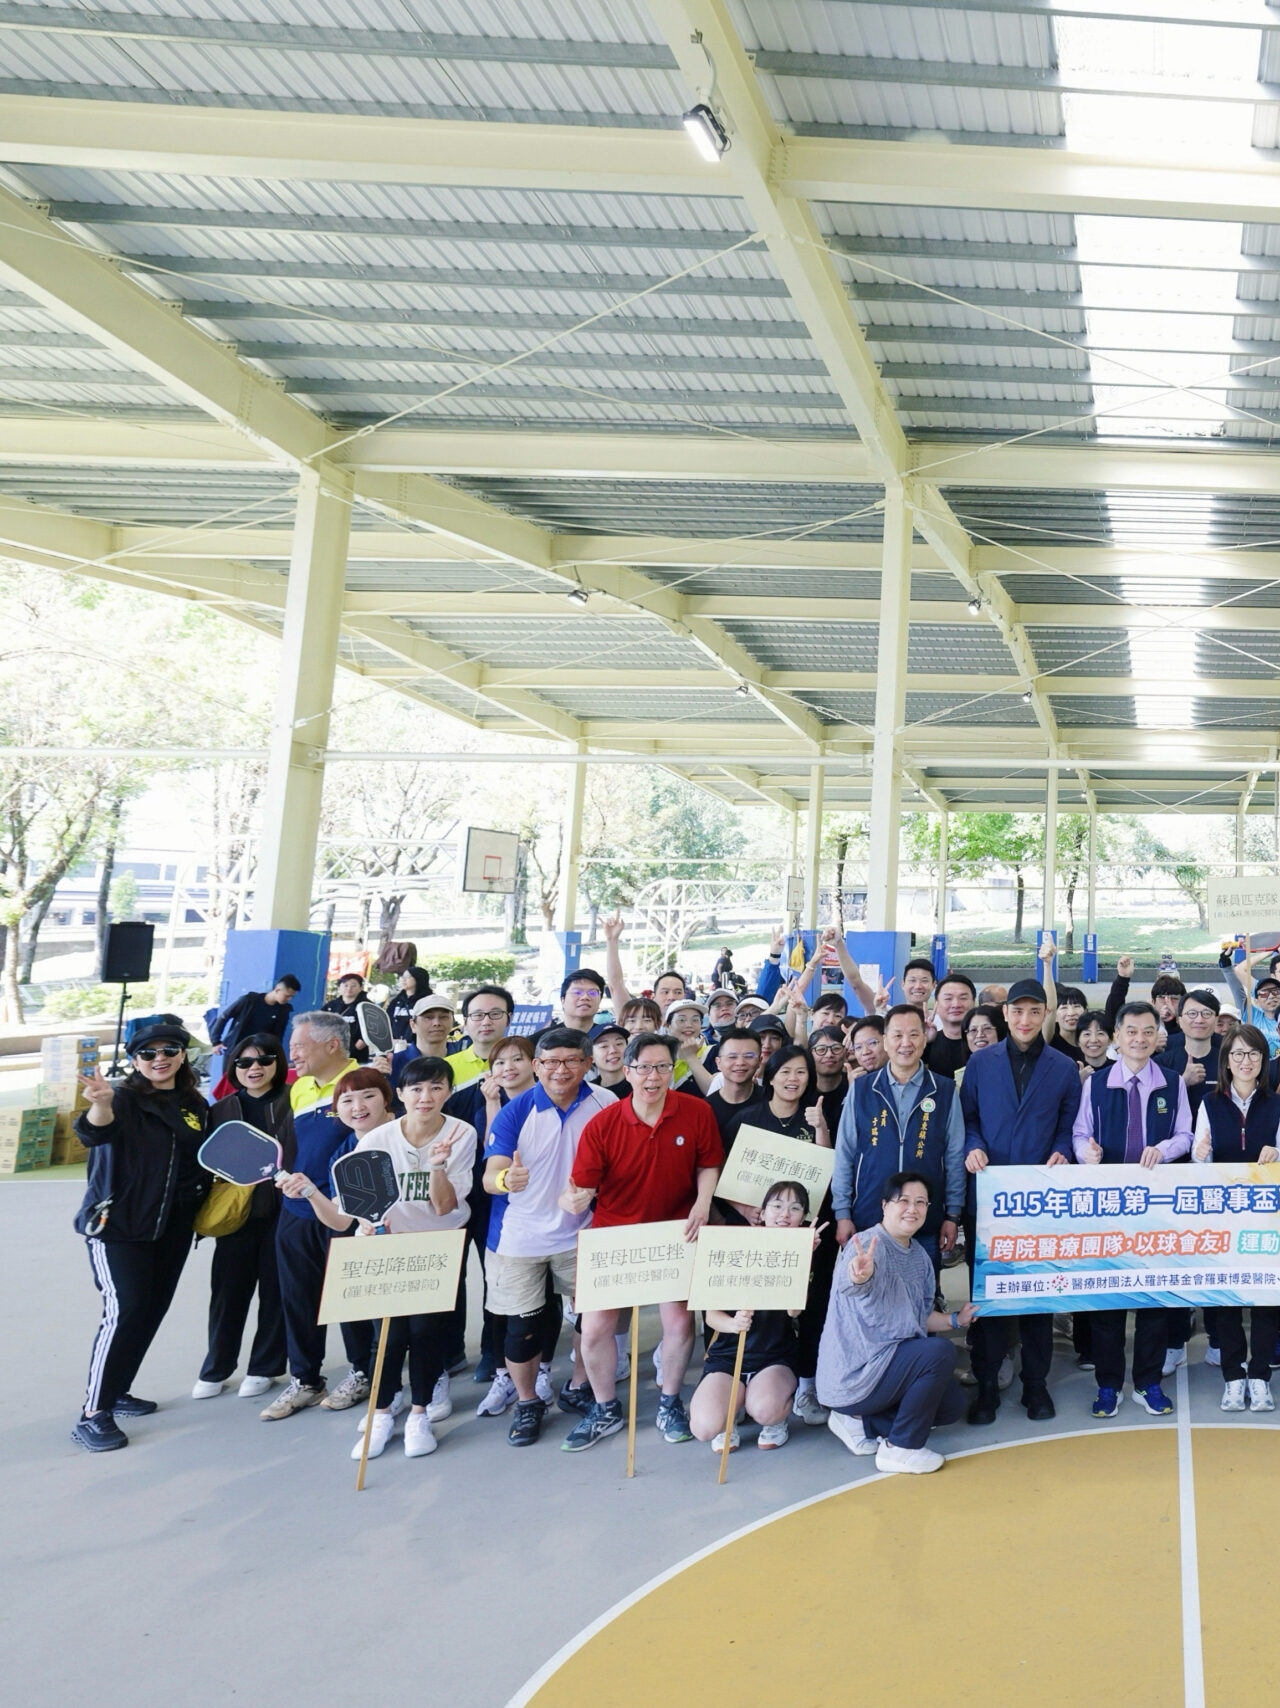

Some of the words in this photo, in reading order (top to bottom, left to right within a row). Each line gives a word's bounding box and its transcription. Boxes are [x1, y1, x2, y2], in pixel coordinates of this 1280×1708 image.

[741, 1147, 823, 1183] 博愛衝衝衝
[590, 1242, 685, 1269] 聖母匹匹挫
[1239, 1230, 1280, 1254] 運動
[340, 1253, 449, 1280] 聖母降臨隊
[708, 1250, 800, 1268] 博愛快意拍
